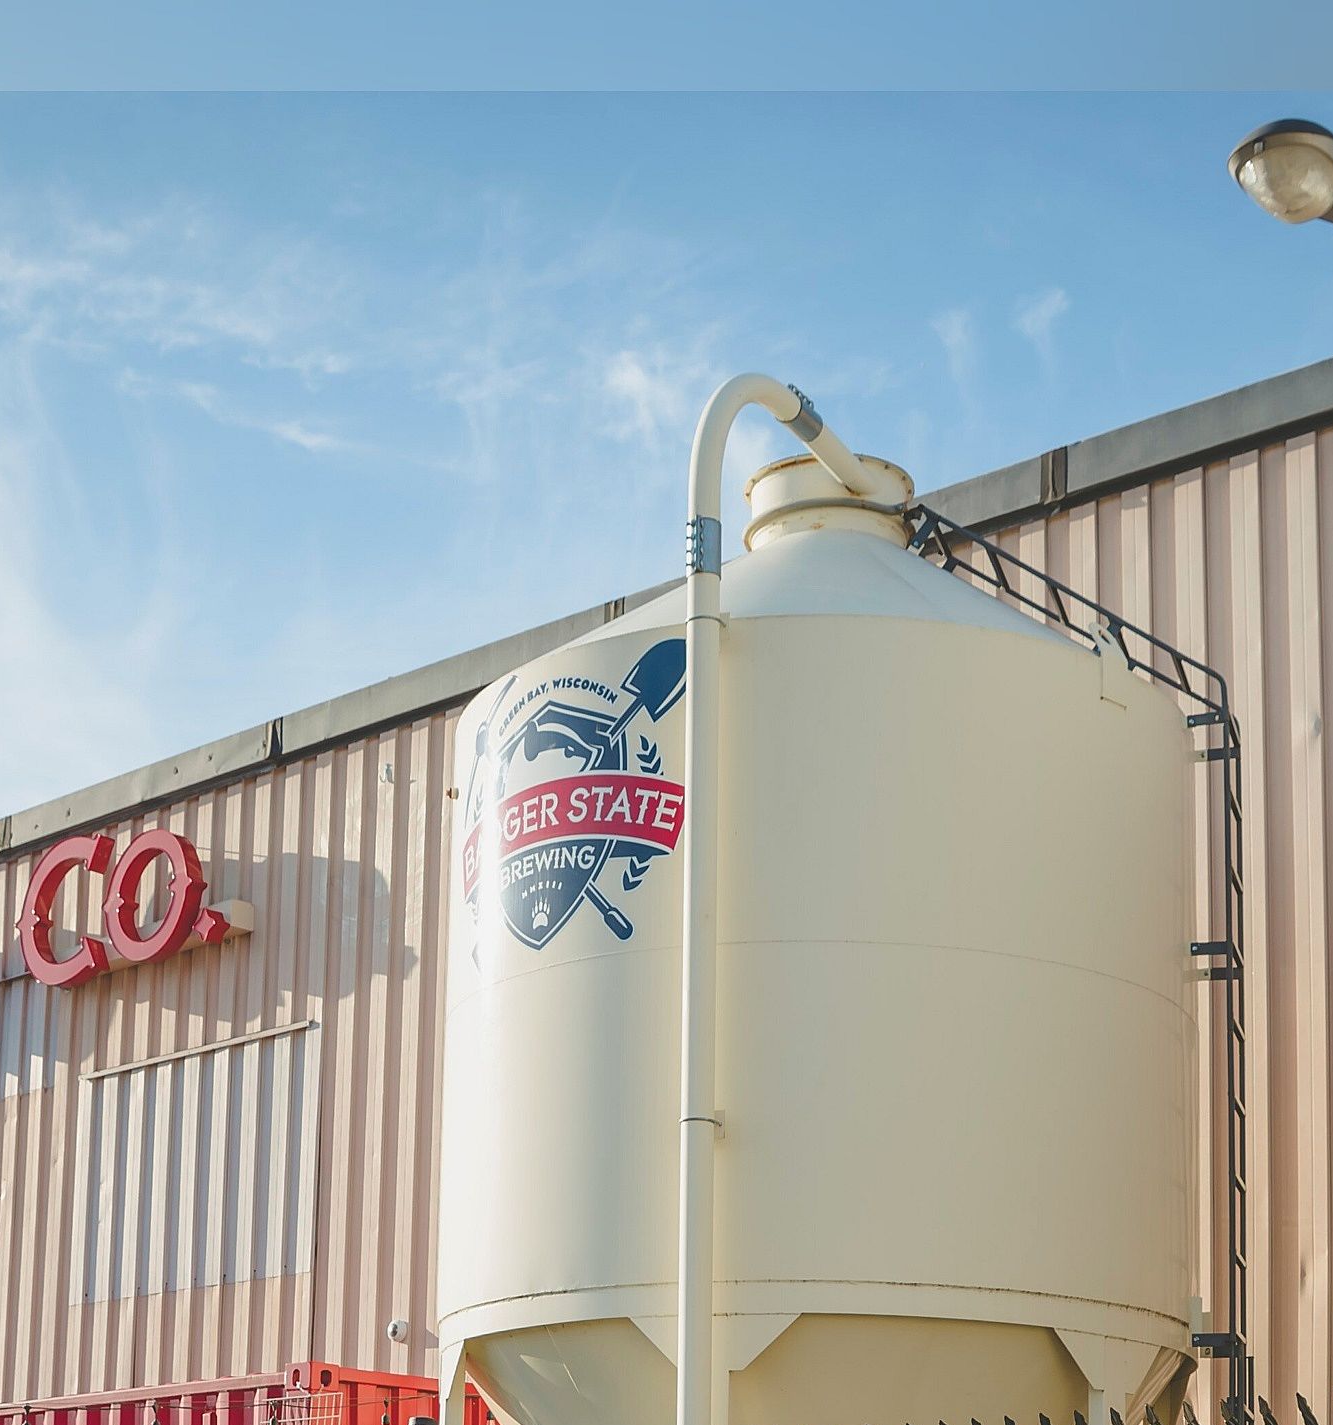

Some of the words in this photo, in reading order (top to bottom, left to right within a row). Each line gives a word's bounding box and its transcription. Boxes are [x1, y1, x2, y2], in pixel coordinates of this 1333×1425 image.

[499, 697, 525, 737] GREEN
[527, 683, 549, 702] BAY,
[553, 677, 618, 704] WISCONSIN
[567, 786, 683, 832] STATE
[500, 846, 595, 890] BREWING
[16, 829, 231, 989] CO.
